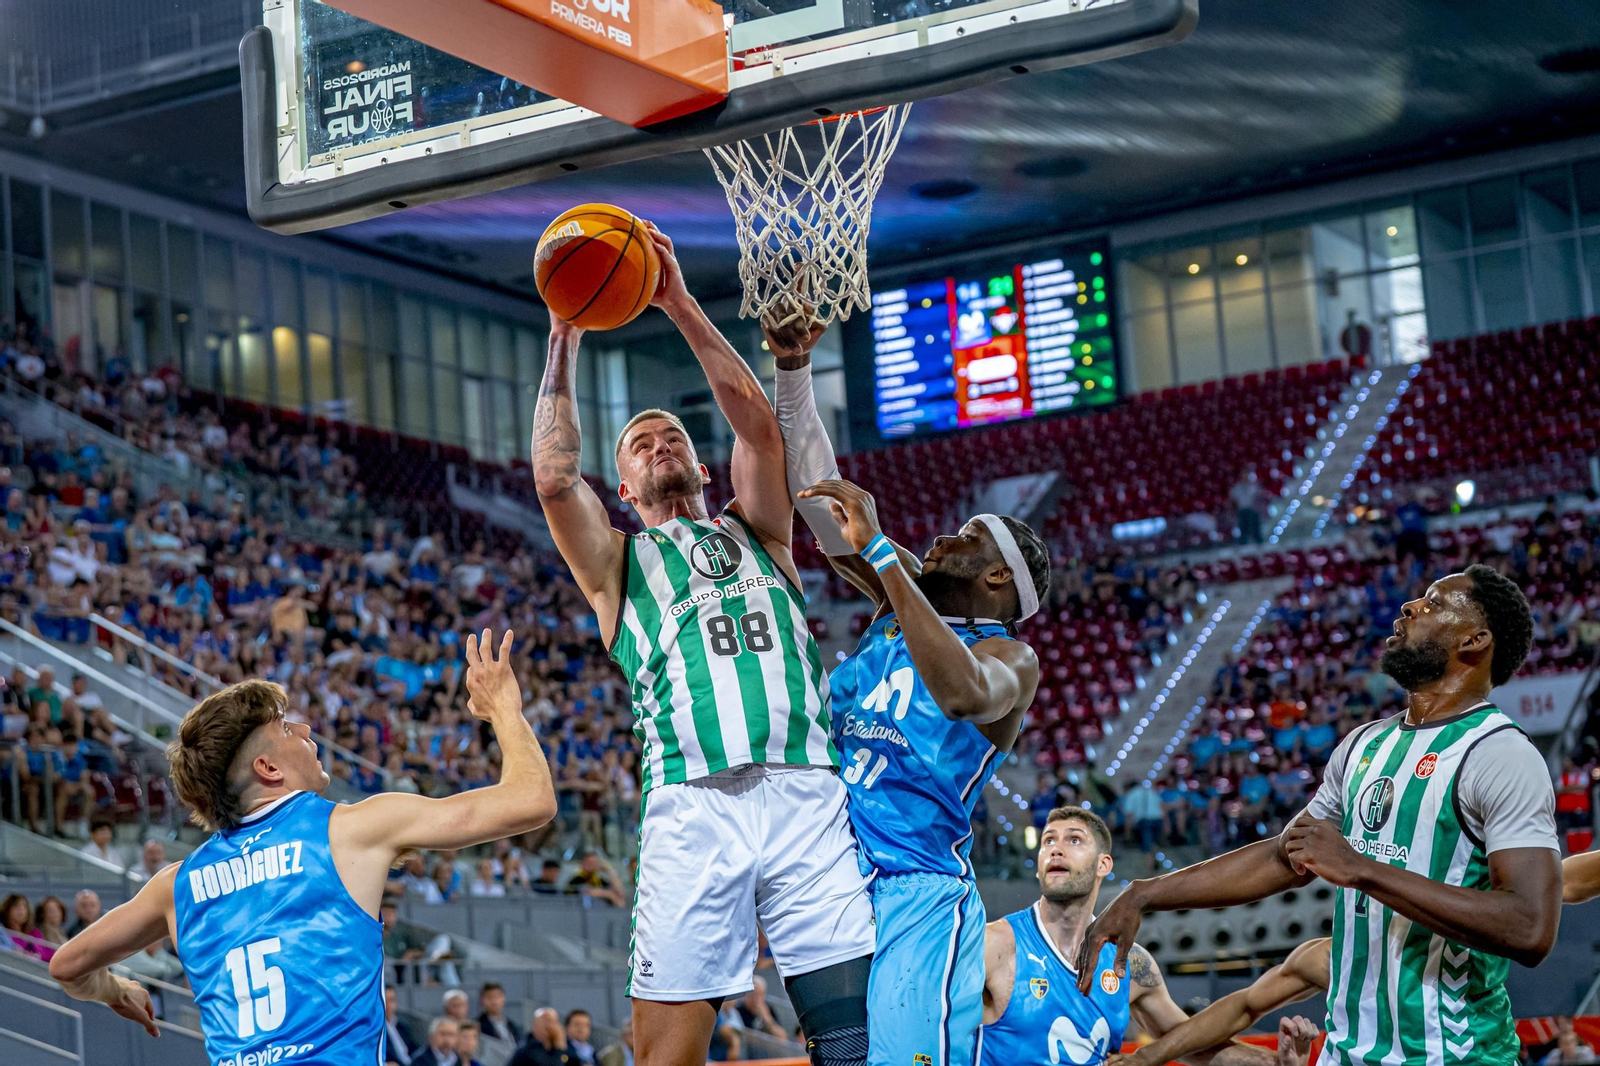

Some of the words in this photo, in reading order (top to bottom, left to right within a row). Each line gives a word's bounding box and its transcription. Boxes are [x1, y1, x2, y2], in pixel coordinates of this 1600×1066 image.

[550, 0, 607, 37] PRIMERA
[607, 25, 632, 47] FEB
[670, 588, 723, 617] GRUPO
[725, 575, 779, 599] HERED
[705, 611, 775, 657] 88
[188, 840, 304, 904] RODRÍGUEZ
[1368, 841, 1408, 861] HEREDA
[225, 936, 287, 1038] 15
